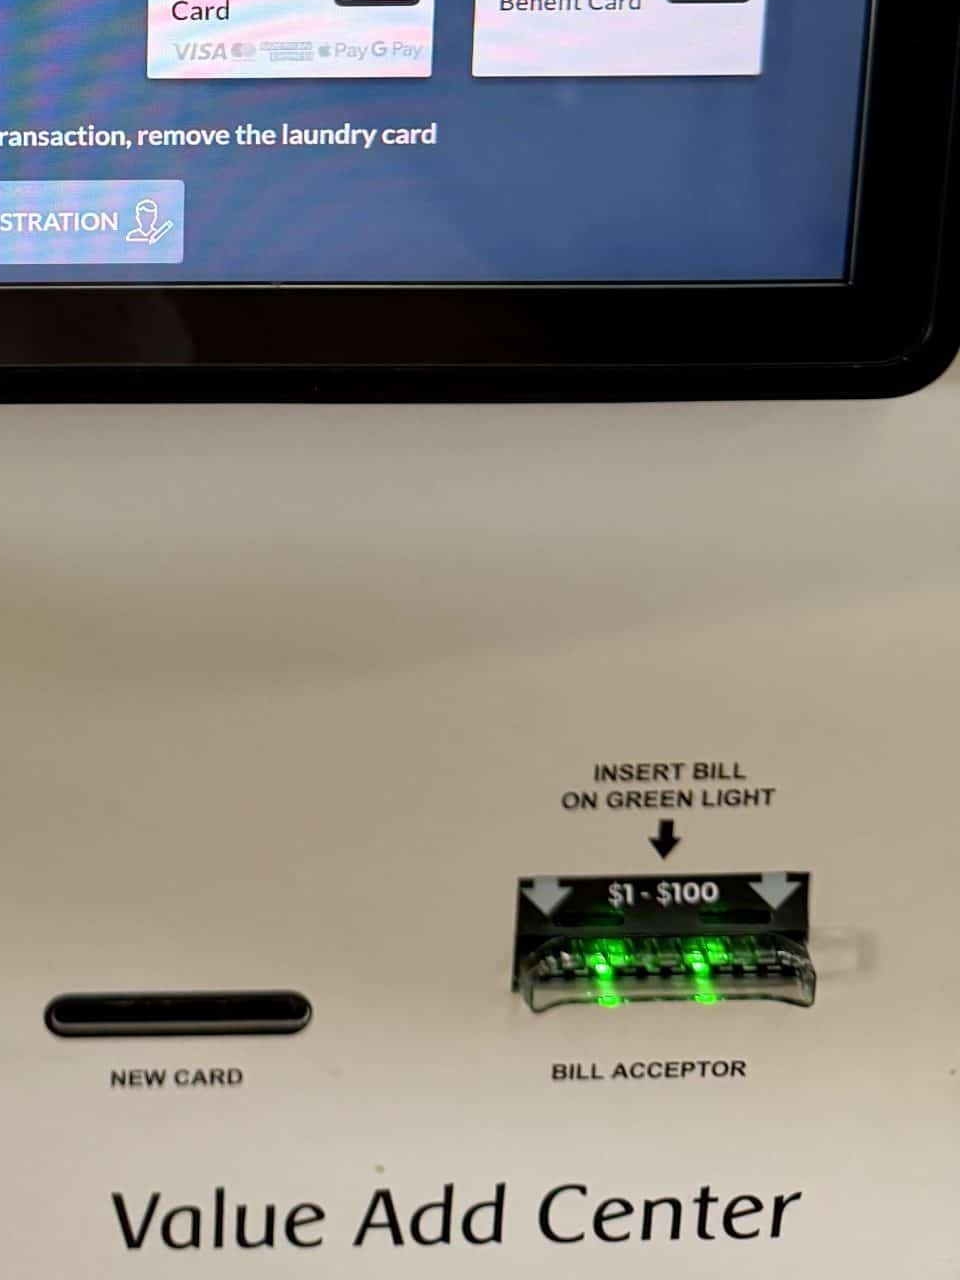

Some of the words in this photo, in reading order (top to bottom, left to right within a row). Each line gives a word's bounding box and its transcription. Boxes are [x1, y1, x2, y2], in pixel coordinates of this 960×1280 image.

[172, 0, 230, 21] Card
[174, 42, 228, 61] VISA
[137, 128, 230, 147] remove
[234, 124, 273, 146] the
[283, 122, 379, 149] laundry
[382, 122, 438, 145] card
[594, 763, 685, 782] INSERT
[692, 762, 747, 780] BILL
[561, 791, 597, 810] ON
[606, 789, 693, 808] GREEN
[701, 788, 776, 807] LIGHT
[608, 880, 634, 907] $1
[656, 880, 720, 907] $100
[110, 1069, 166, 1088] NEW
[173, 1067, 244, 1087] CARD
[551, 1061, 603, 1081] BILL
[611, 1059, 747, 1080] ACCEPTOR
[111, 1186, 325, 1252] Value
[353, 1183, 506, 1248] Add
[537, 1182, 803, 1245] Center
